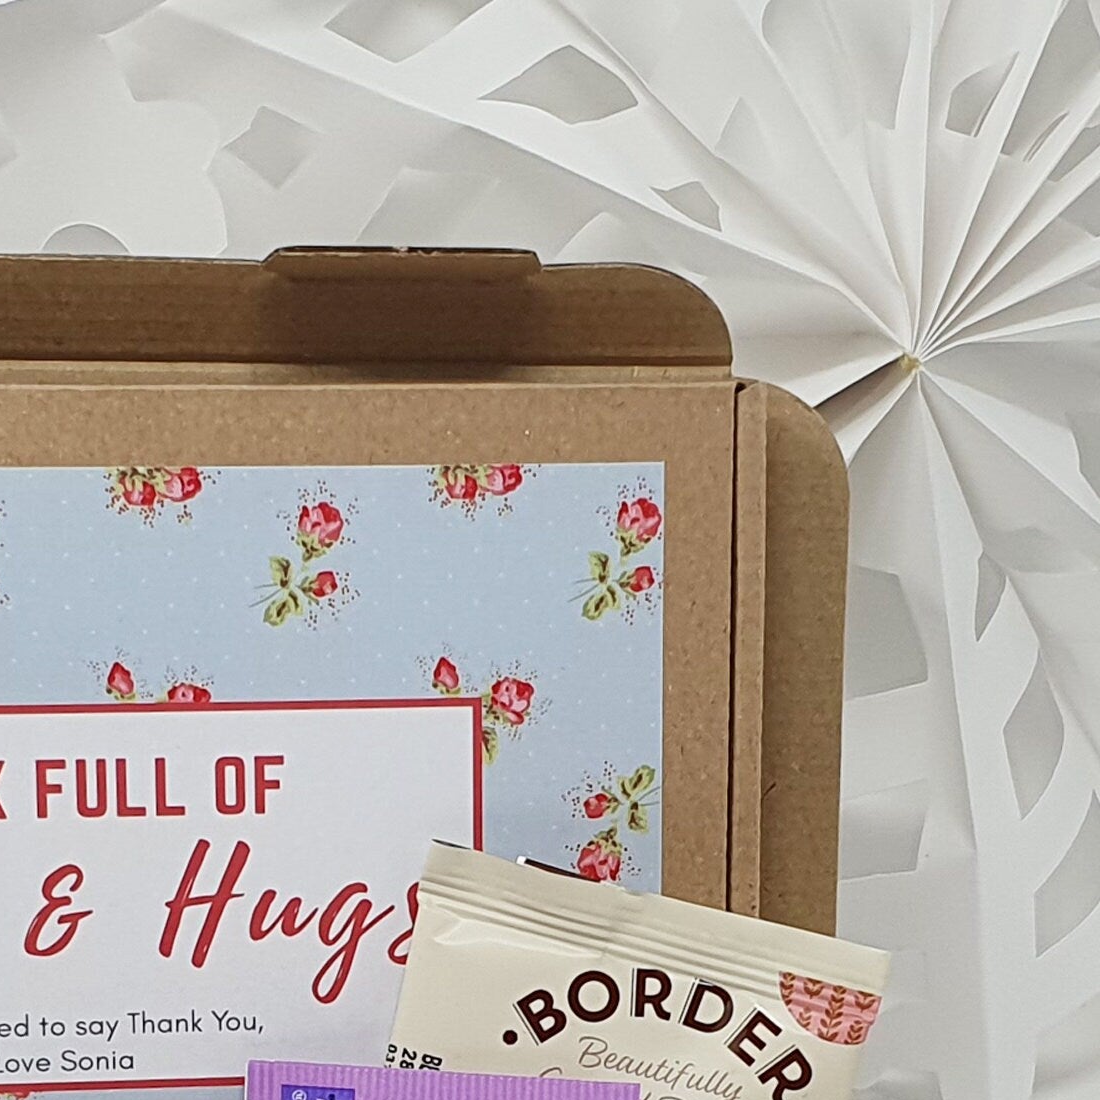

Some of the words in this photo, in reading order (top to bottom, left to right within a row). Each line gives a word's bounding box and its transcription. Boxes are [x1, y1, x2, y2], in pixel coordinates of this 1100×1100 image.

[36, 757, 185, 819] FULL
[213, 755, 286, 815] OF
[23, 864, 94, 957] &
[39, 1016, 66, 1036] to
[75, 1016, 119, 1041] say
[127, 1010, 203, 1034] Thank
[210, 1010, 264, 1035] You,
[60, 1049, 135, 1072] Sonia
